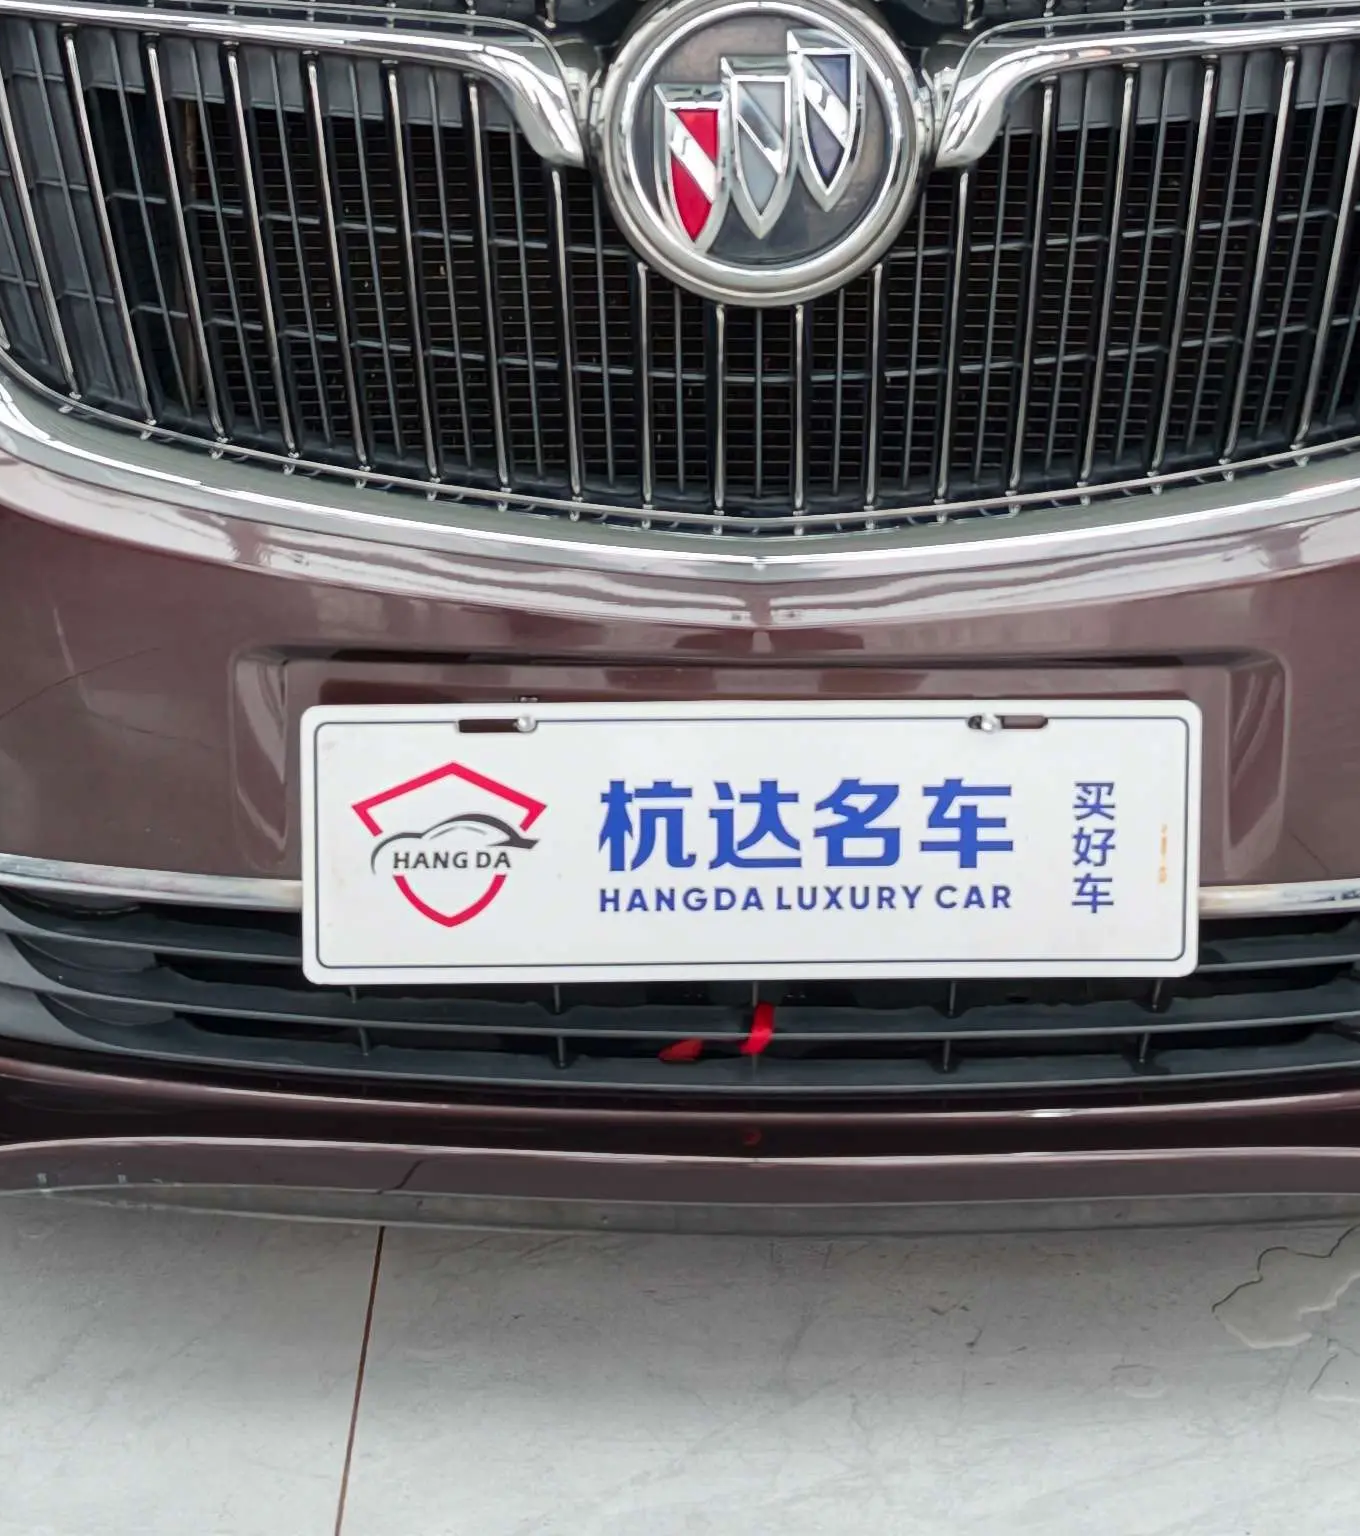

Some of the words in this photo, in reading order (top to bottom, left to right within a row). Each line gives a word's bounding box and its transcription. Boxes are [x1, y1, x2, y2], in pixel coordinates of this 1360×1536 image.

[598, 778, 1014, 871] 杭达名车
[1071, 781, 1116, 914] 买好车
[393, 851, 468, 869] HANG
[475, 851, 512, 869] DA
[599, 887, 764, 913] HANGDA
[776, 885, 922, 911] LUXURY
[935, 885, 1012, 910] CAR
